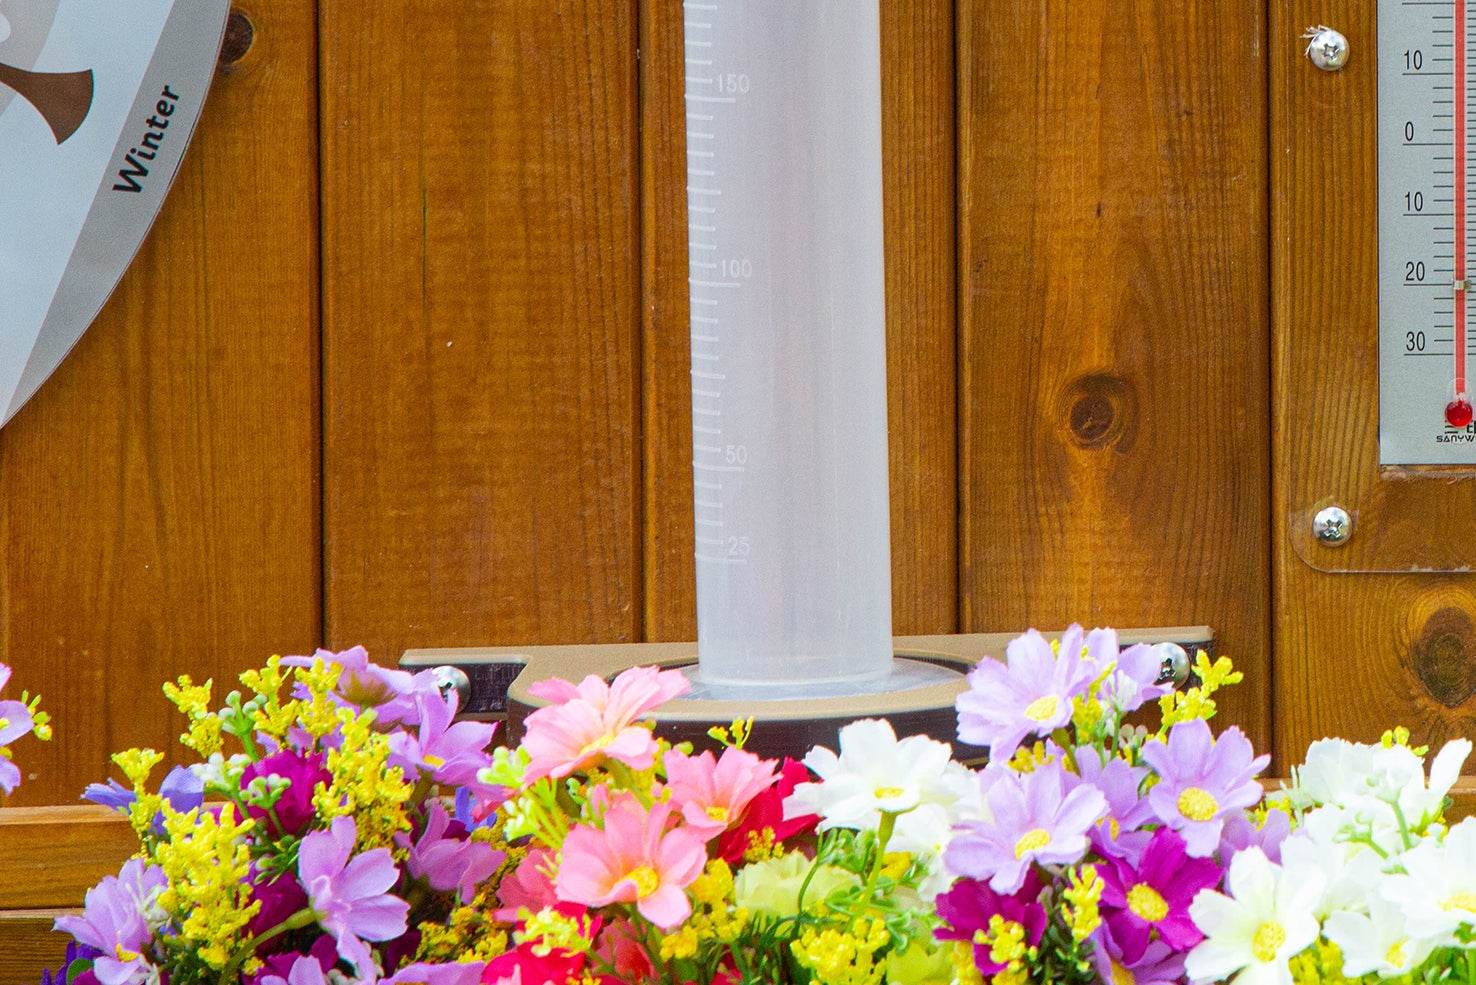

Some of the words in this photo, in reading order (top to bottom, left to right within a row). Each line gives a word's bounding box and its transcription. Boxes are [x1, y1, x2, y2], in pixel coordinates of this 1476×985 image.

[1404, 49, 1423, 70] 10
[717, 74, 749, 94] 150
[112, 84, 180, 194] Winter
[1404, 121, 1414, 142] 0
[1404, 191, 1424, 212] 10
[720, 259, 752, 278] 100
[1405, 261, 1426, 282] 20
[1405, 330, 1426, 352] 30
[726, 445, 747, 464] 50
[728, 537, 750, 556] 25
